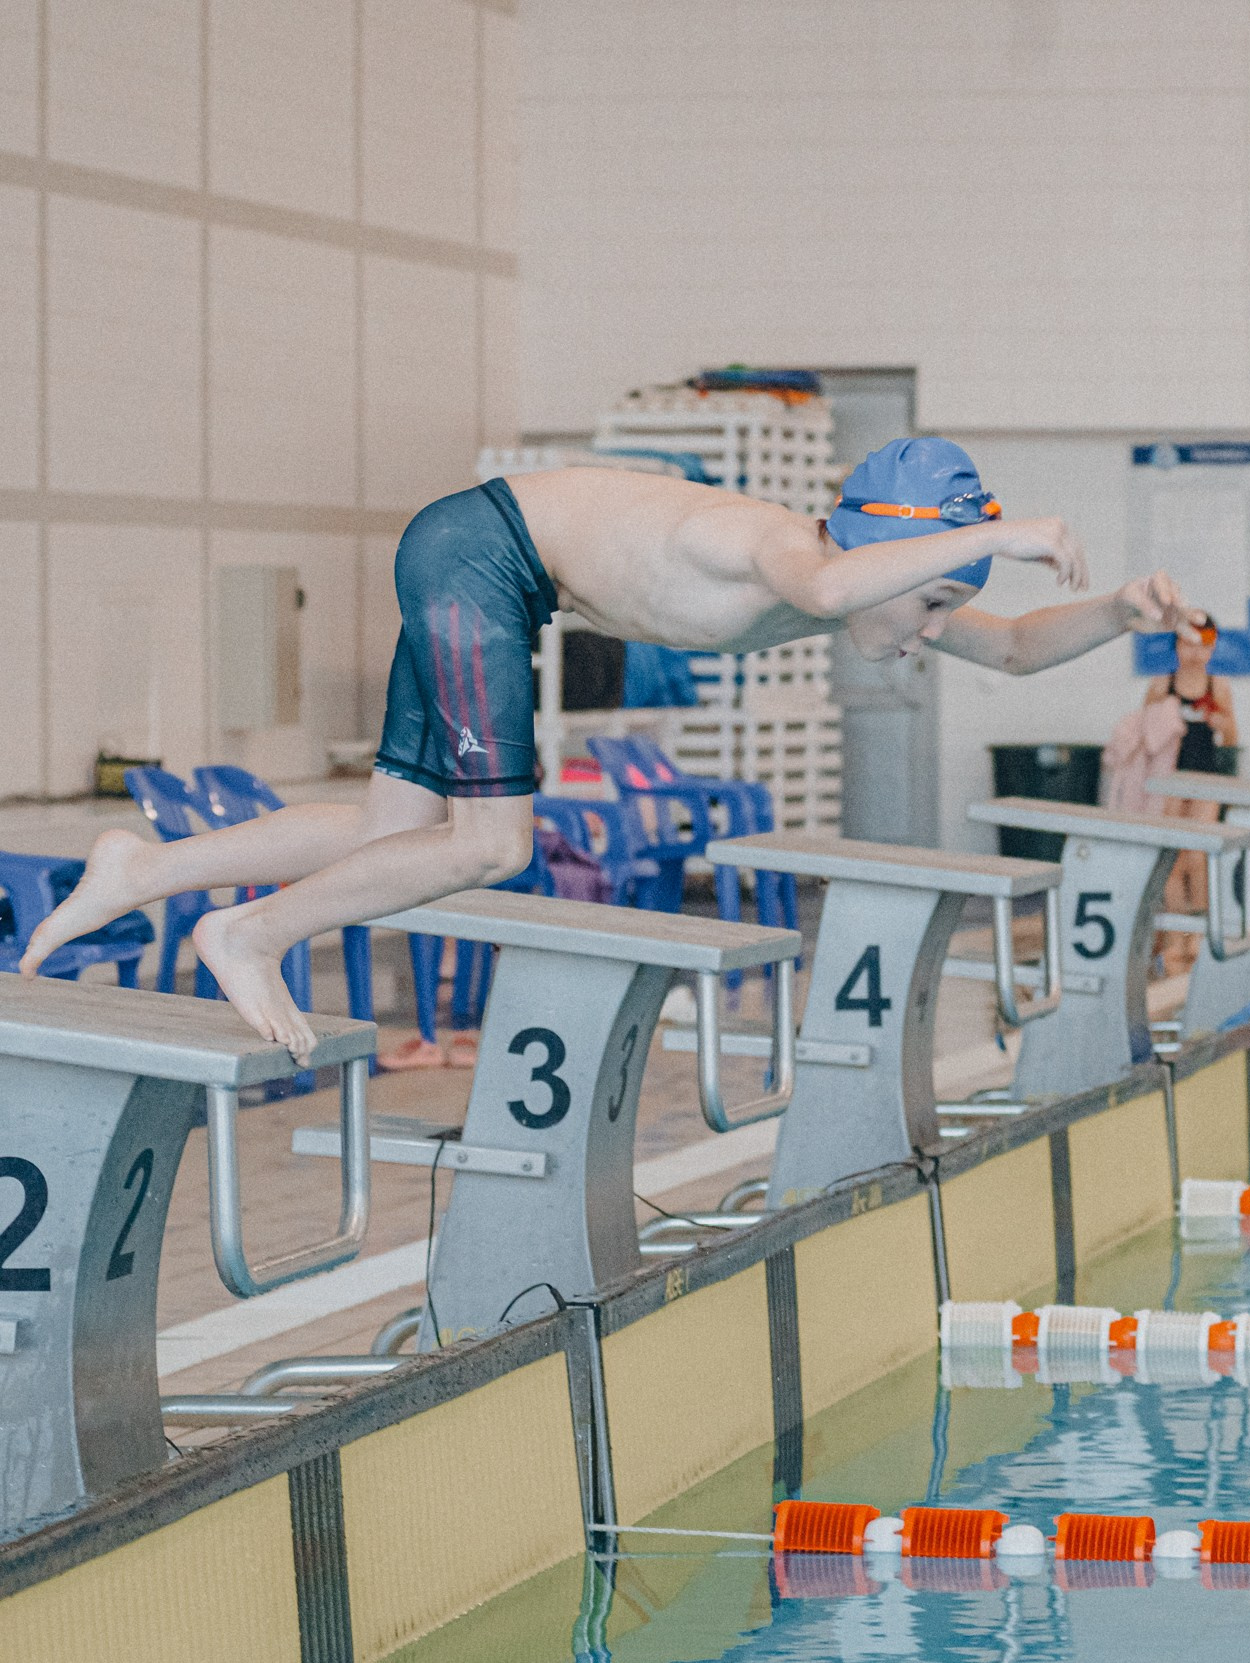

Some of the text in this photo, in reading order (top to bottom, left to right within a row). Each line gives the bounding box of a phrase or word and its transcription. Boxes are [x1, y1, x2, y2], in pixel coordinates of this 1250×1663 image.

[1073, 891, 1116, 960] 5
[834, 944, 892, 1028] 4
[507, 1027, 571, 1130] 3
[607, 1024, 639, 1122] 3
[0, 1156, 51, 1291] 2
[106, 1147, 155, 1282] 2
